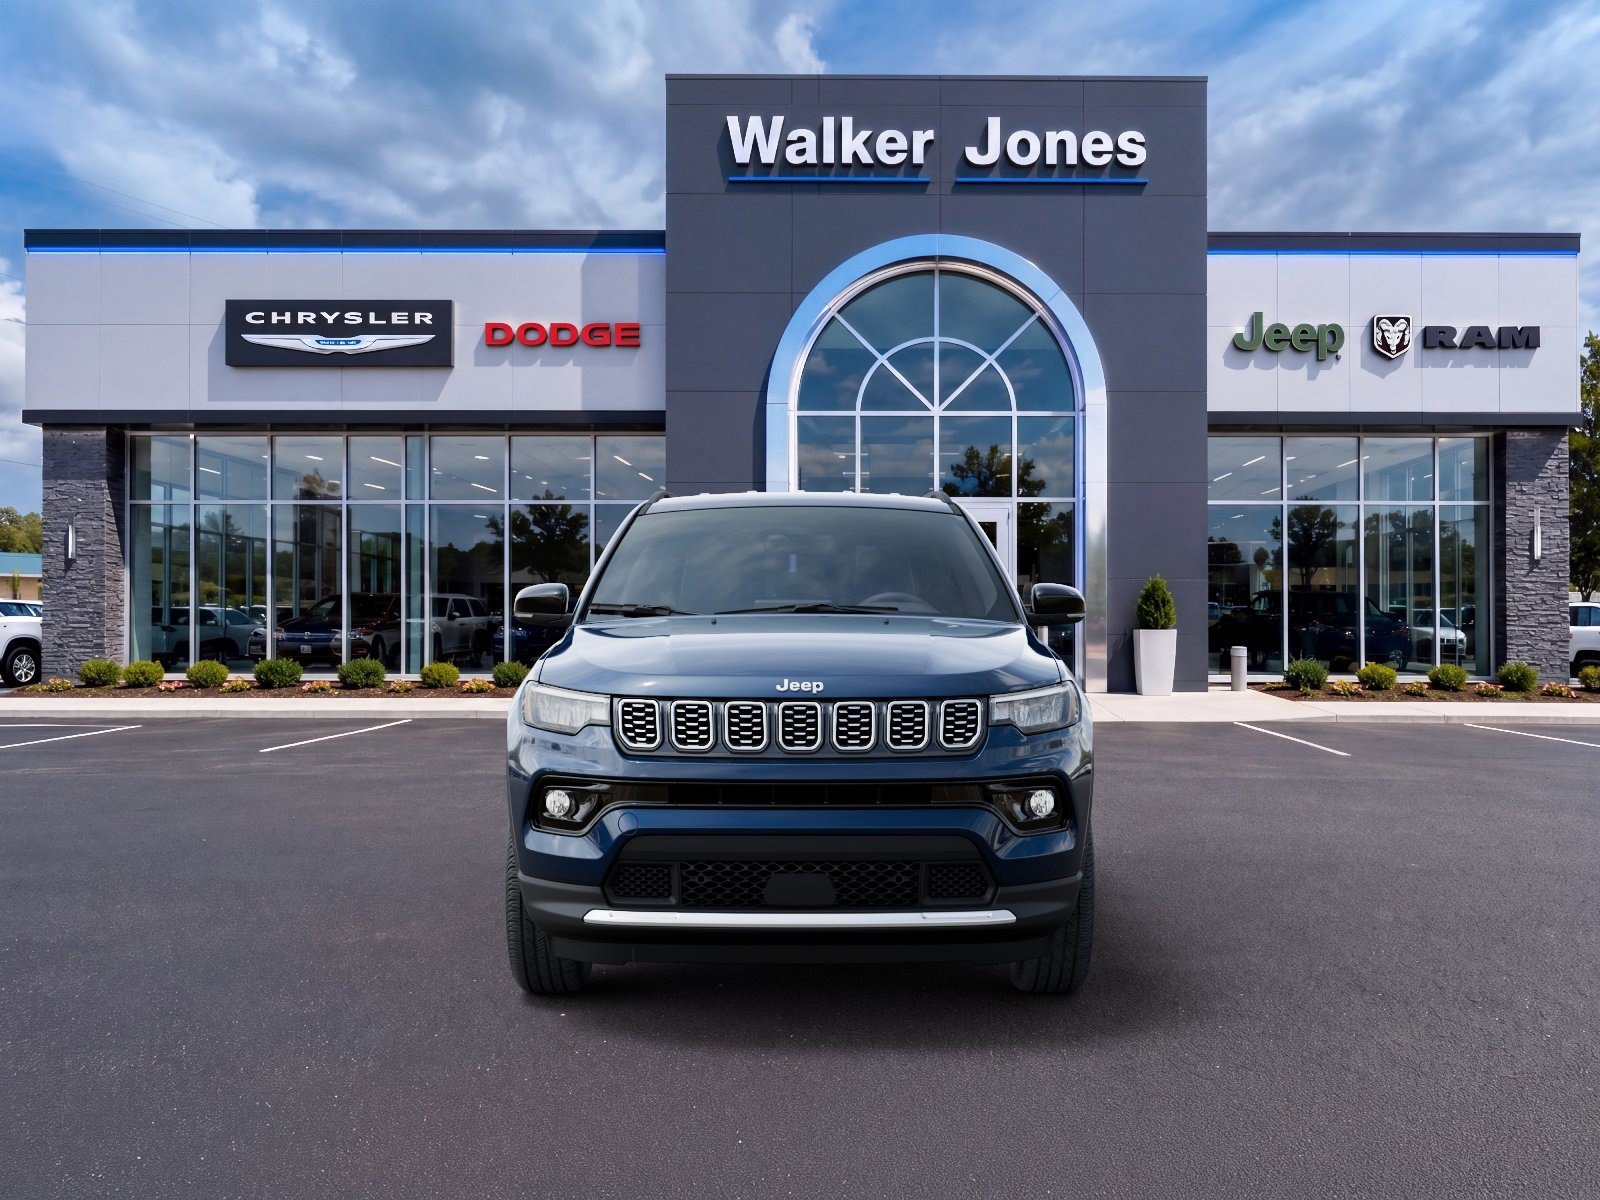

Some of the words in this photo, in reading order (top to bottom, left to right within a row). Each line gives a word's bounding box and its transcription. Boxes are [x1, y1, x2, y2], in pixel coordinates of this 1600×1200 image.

[726, 115, 935, 166] Walker
[964, 116, 1148, 167] Jones
[245, 311, 433, 325] CHRYSLER
[485, 322, 641, 347] DODGE
[1234, 311, 1345, 361] Jeep
[1423, 325, 1541, 349] RAM
[775, 678, 824, 694] Jeep
